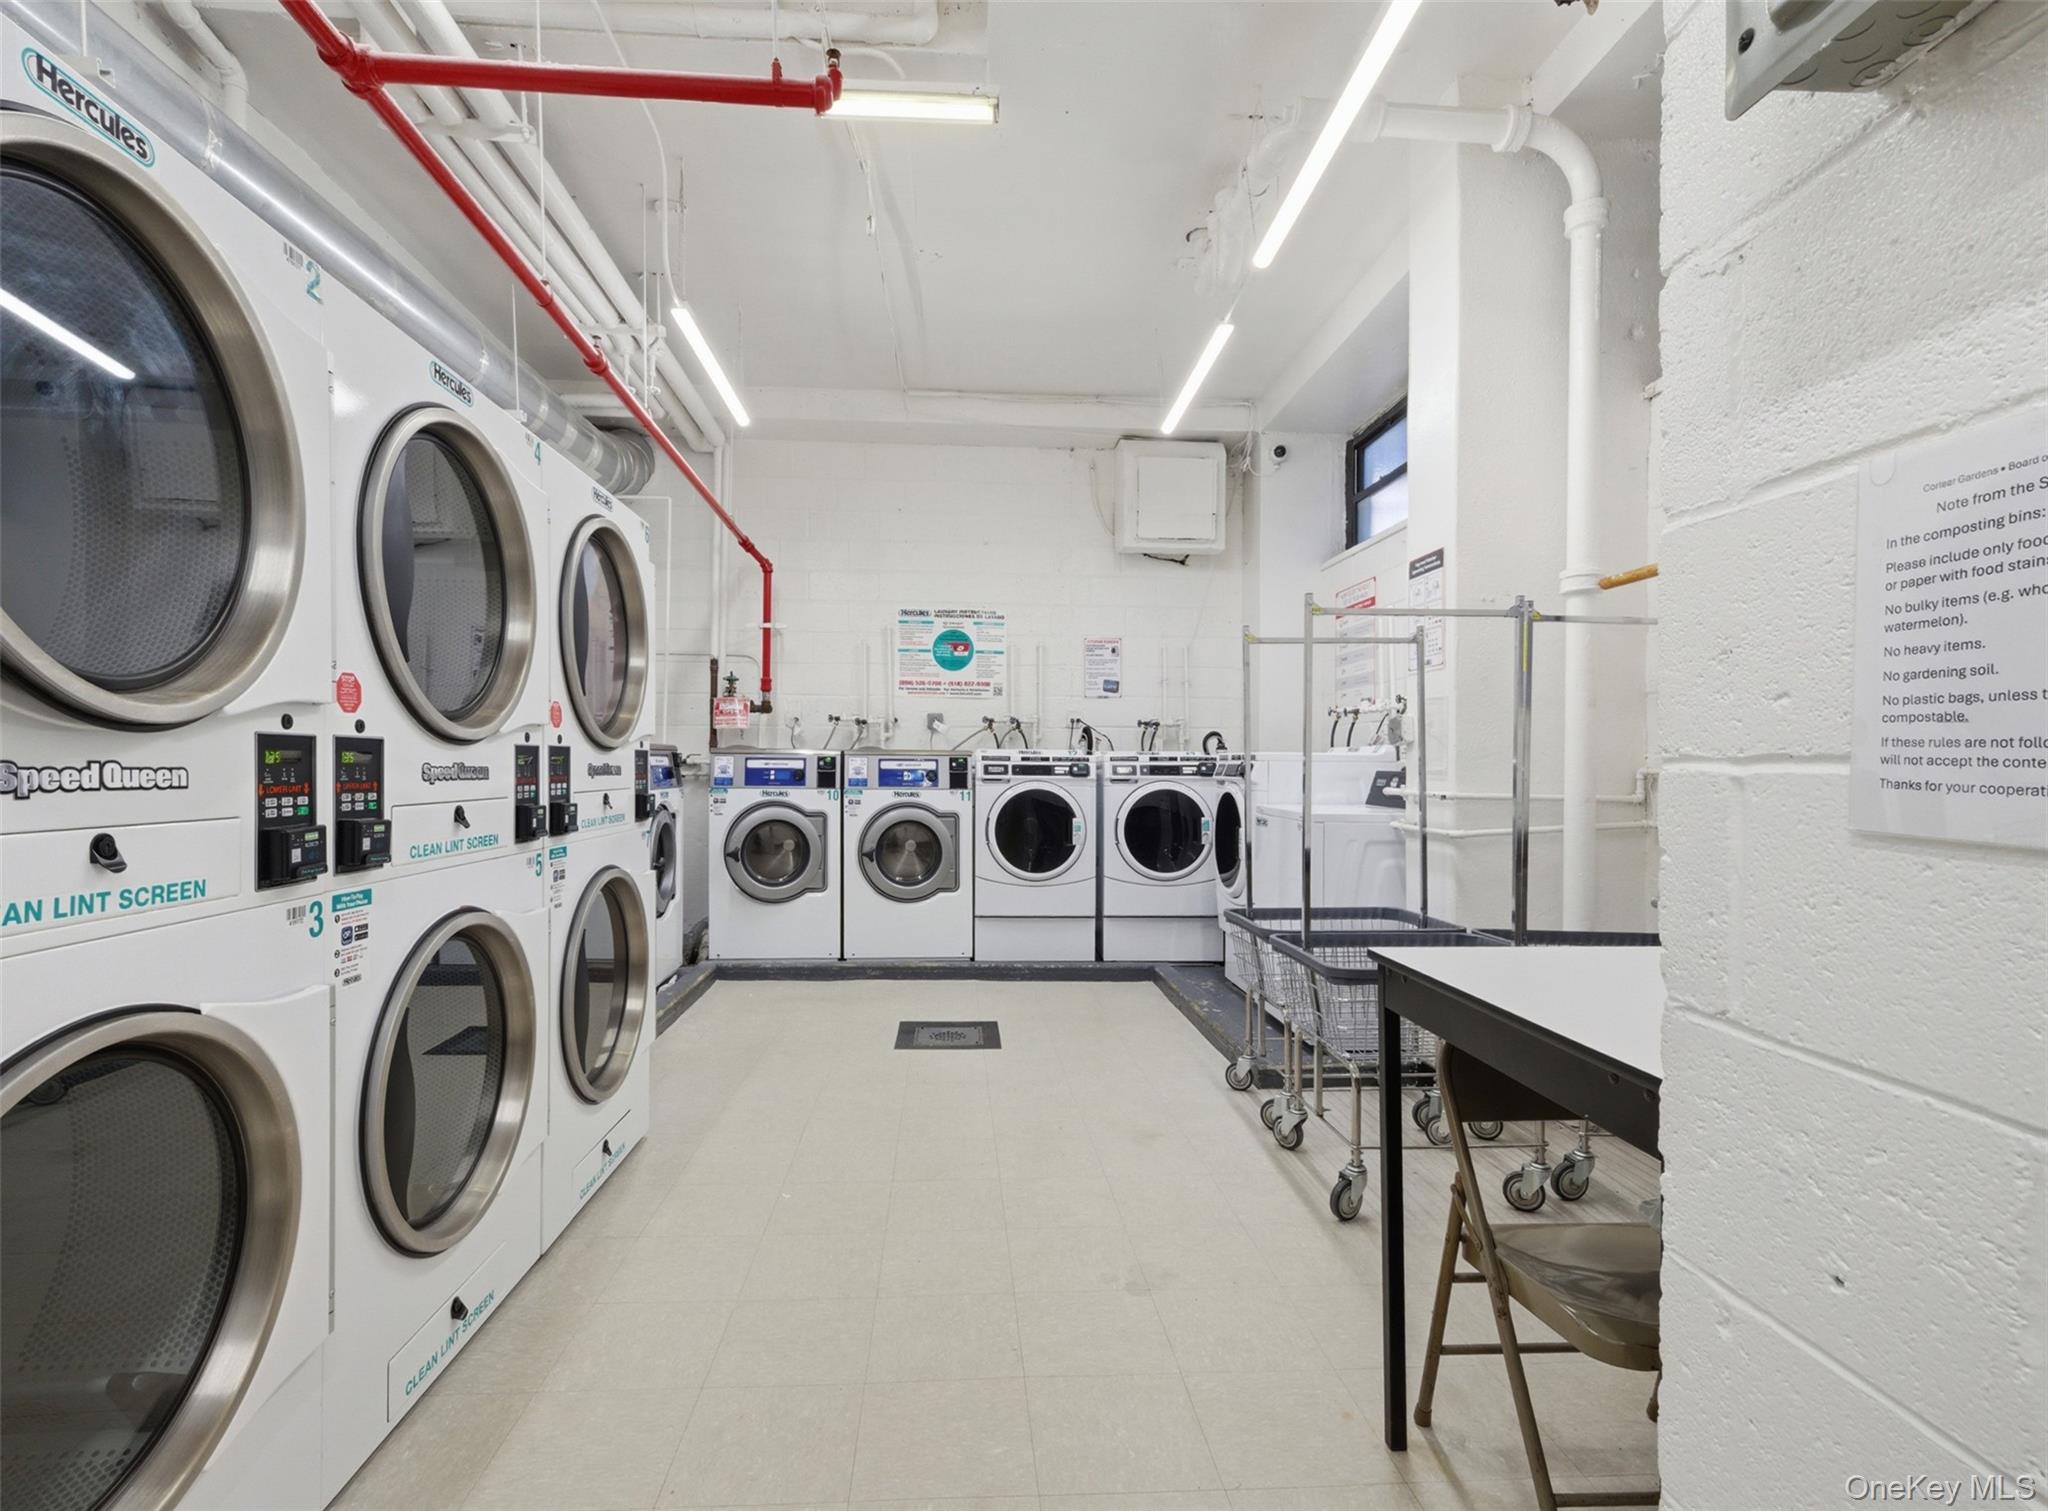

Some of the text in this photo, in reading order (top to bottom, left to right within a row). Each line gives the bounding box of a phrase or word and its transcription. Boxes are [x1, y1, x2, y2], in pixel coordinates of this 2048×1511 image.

[36, 53, 148, 160] Hercules
[305, 260, 323, 304] 2
[433, 362, 472, 404] Hercules
[534, 442, 541, 466] 4
[1957, 467, 1999, 484] Gardens
[2008, 455, 2040, 471] Board
[1936, 498, 1969, 513] Note
[1973, 489, 2007, 505] from
[2010, 480, 2036, 497] the
[1886, 508, 2047, 549] In the composting bins:
[1886, 557, 1927, 574] Please
[1929, 548, 1980, 566] include
[1983, 541, 2015, 556] only
[1885, 554, 2048, 592] or paper with food stain
[1884, 604, 1902, 616] No
[1904, 598, 1939, 614] bulky
[1941, 594, 1980, 608] items
[1983, 589, 2015, 605] (e.g.
[1884, 613, 1969, 633] watermelon).
[1883, 639, 1987, 657] No heavy items.
[1882, 663, 1999, 683] No gardening soil.
[1882, 695, 1899, 706] No
[1902, 693, 1945, 707] plastic
[1948, 692, 1985, 705] bags,
[1988, 689, 2038, 702] unless
[1881, 711, 1969, 725] compostable.
[1880, 737, 1889, 748] If
[1891, 737, 1925, 748] these
[1928, 736, 1961, 748] rules
[1964, 739, 1987, 748] are
[1990, 738, 2014, 749] not
[1880, 754, 2047, 769] will not accept the conte
[826, 790, 840, 801] 10
[960, 791, 972, 801] 11
[1880, 778, 1922, 791] Thanks
[1925, 780, 1943, 792] for
[1945, 782, 1976, 795] your
[410, 834, 499, 859] CLEAN LINT SCREEN
[535, 852, 543, 877] 5
[53, 891, 111, 919] LINT
[118, 879, 207, 910] SCREEN
[309, 900, 324, 938] 3
[405, 1289, 495, 1396] CLEAN LINT SCREEN
